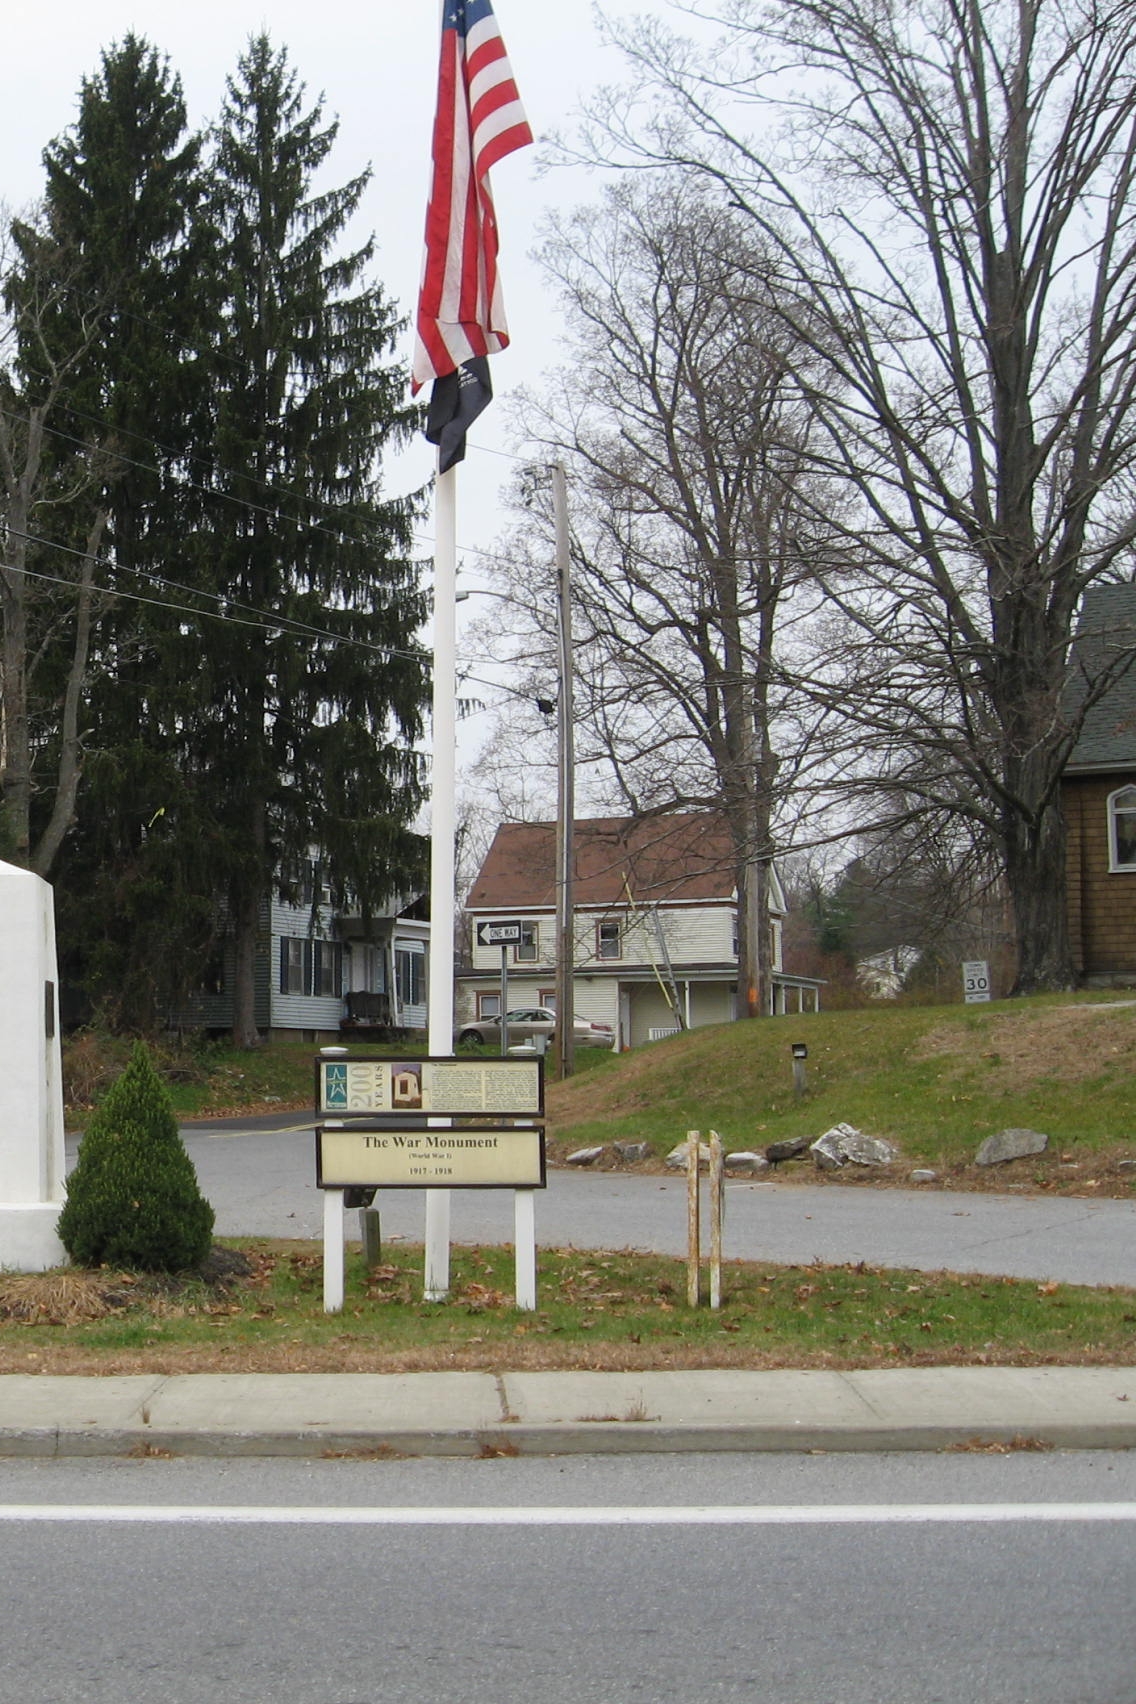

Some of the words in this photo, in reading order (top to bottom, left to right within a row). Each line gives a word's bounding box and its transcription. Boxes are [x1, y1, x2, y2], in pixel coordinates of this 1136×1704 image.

[489, 928, 503, 938] ONE
[504, 927, 518, 937] WAY
[966, 977, 987, 990] 30
[351, 1065, 373, 1108] 200
[375, 1064, 384, 1108] YEARS
[363, 1136, 389, 1149] The
[392, 1136, 422, 1149] War
[425, 1136, 499, 1149] Monument
[409, 1152, 431, 1160] (World
[432, 1152, 445, 1160] War
[409, 1167, 427, 1175] 1917
[434, 1167, 453, 1175] 1918
